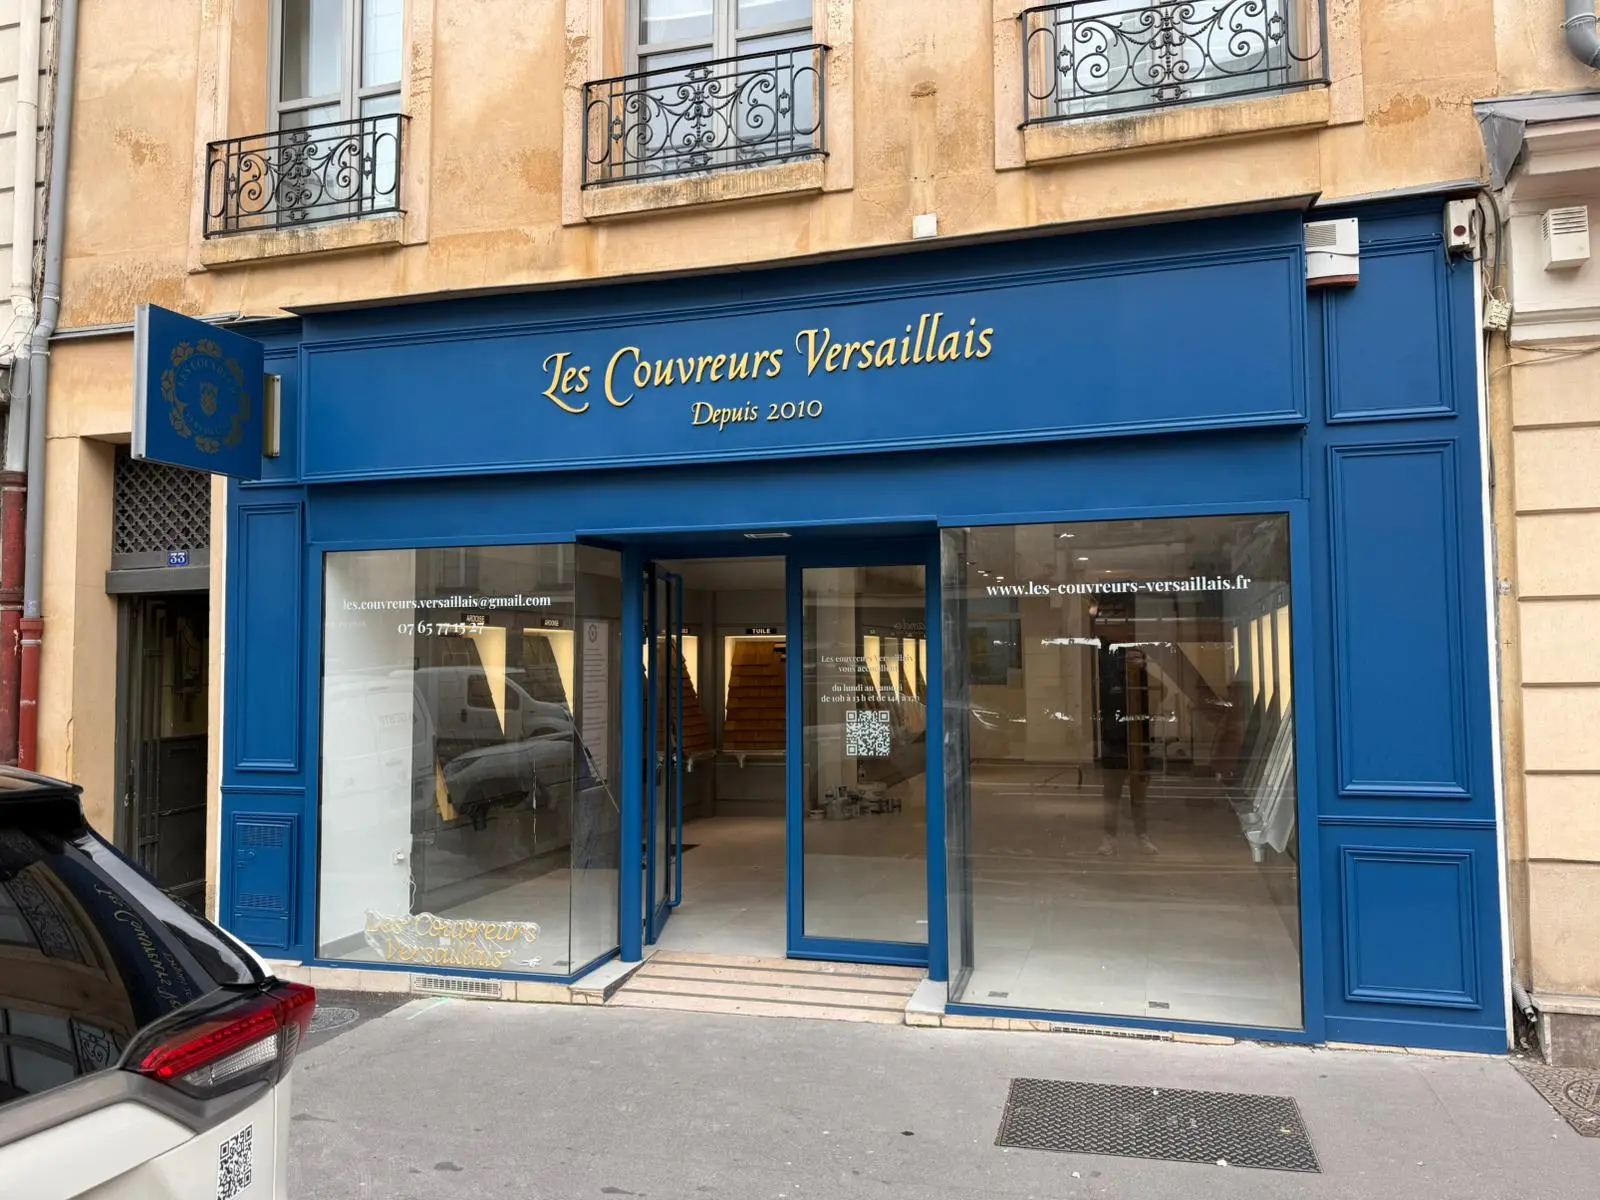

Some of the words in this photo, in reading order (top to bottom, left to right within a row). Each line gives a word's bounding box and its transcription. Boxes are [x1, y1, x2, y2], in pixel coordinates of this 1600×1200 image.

[541, 351, 591, 414] Les
[604, 346, 784, 407] Couvreurs
[795, 312, 995, 377] Versaillais
[691, 401, 758, 432] Depuis
[766, 399, 823, 421] 2010
[170, 552, 185, 564] 33
[986, 574, 1252, 596] www.les-couvreurs-versaillais.fr
[343, 594, 551, 610] les.couvreurs.versaillais@gmail.com
[398, 623, 414, 636] 07
[417, 620, 433, 636] 65
[436, 623, 451, 635] 77
[415, 912, 540, 942] Couvreurs
